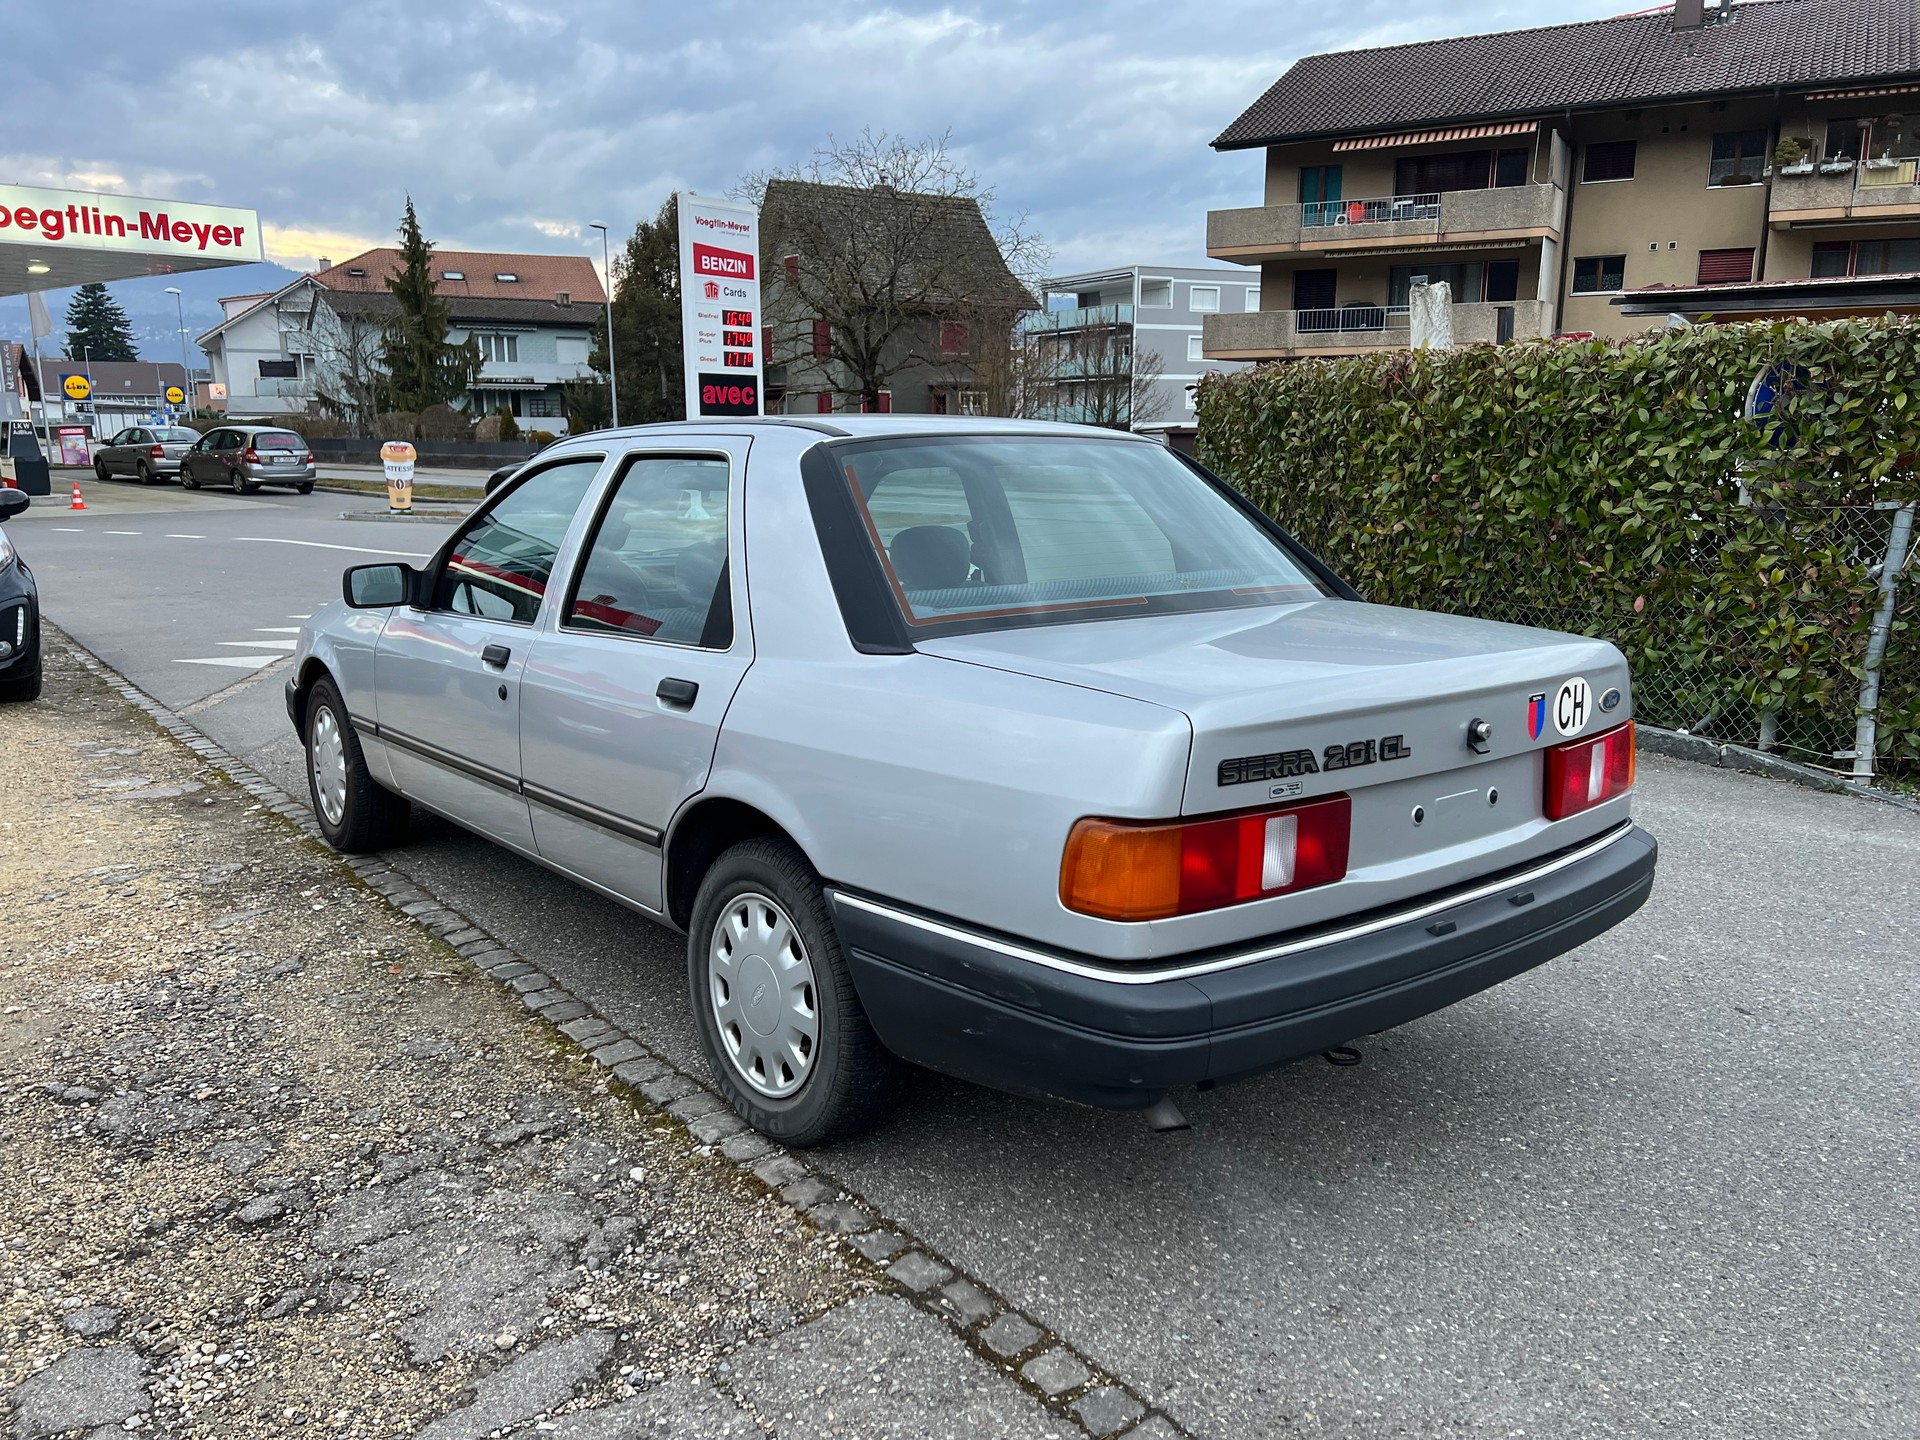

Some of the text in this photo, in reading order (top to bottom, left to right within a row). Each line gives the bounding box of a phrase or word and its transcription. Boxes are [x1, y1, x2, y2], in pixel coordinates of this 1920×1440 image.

[694, 216, 750, 232] Voegtlin-Meyer
[701, 255, 746, 274] BENZIN
[723, 286, 747, 298] Cards
[703, 385, 755, 405] avec
[1558, 683, 1585, 730] CH
[1379, 734, 1411, 762] CL
